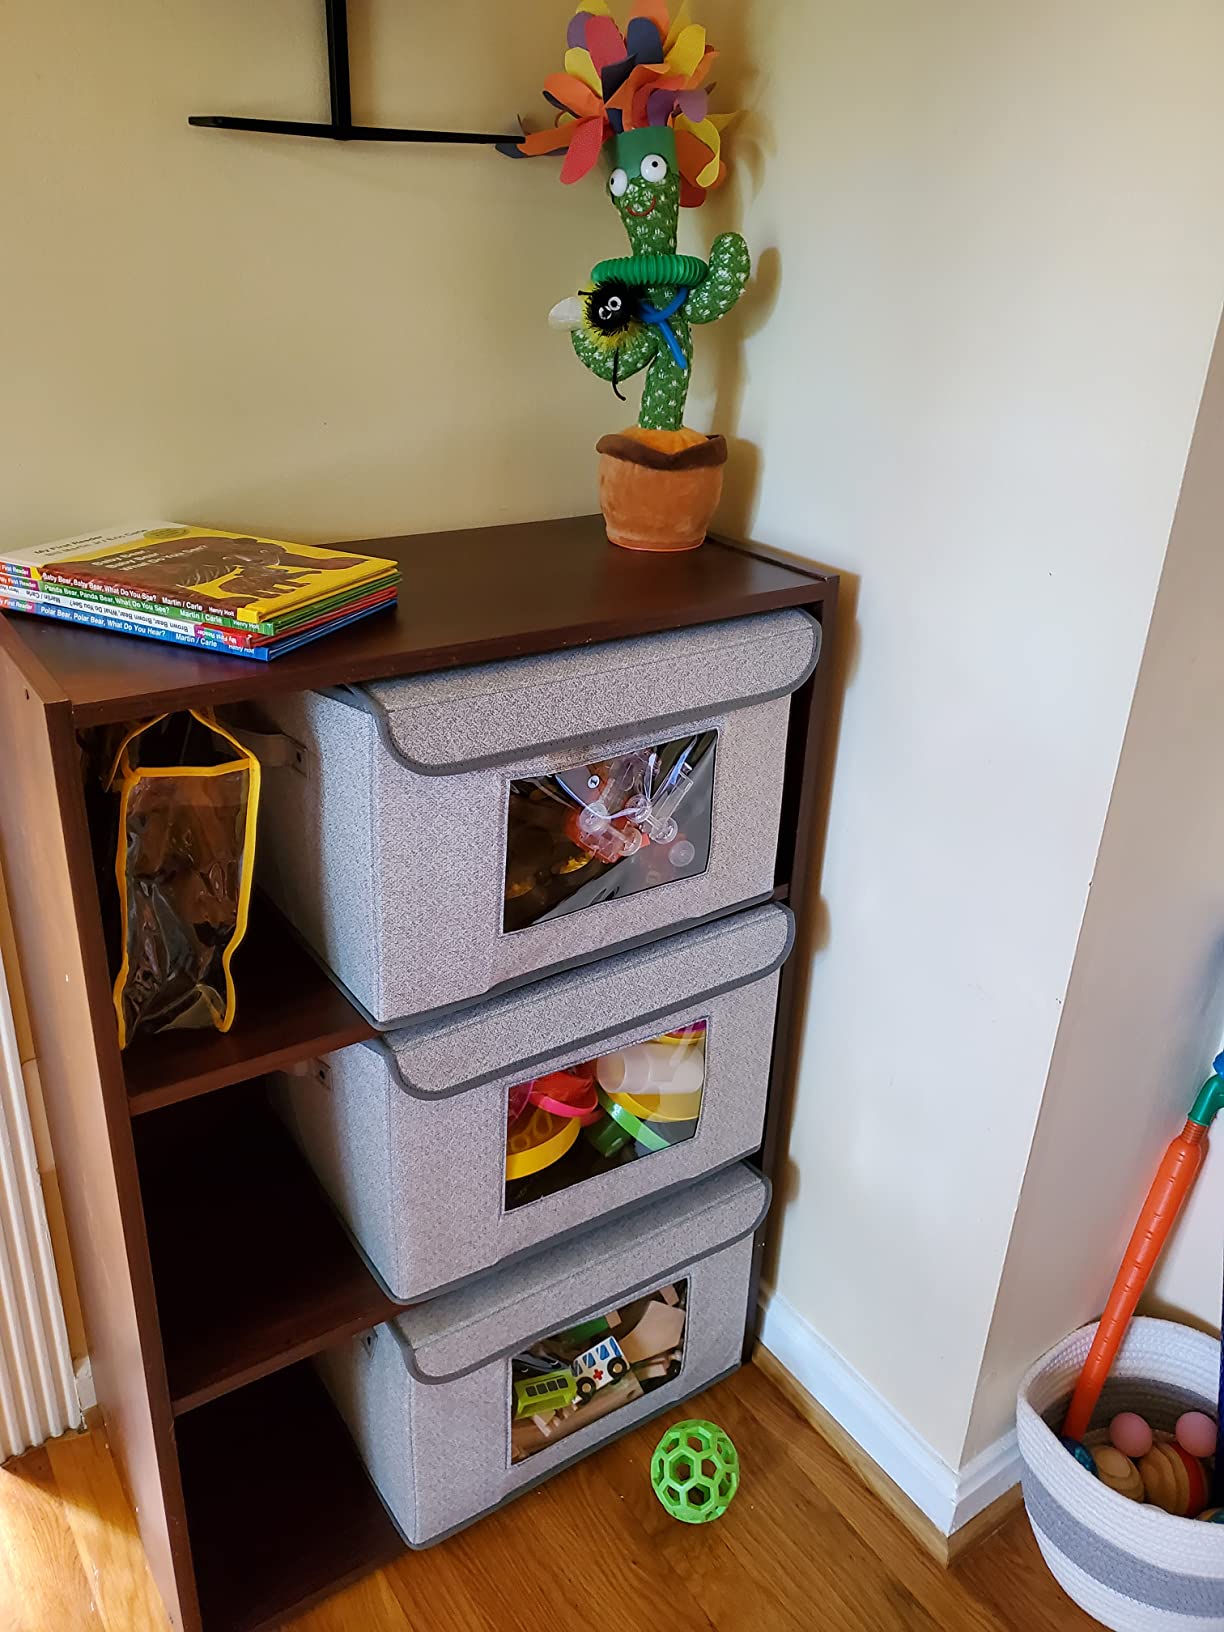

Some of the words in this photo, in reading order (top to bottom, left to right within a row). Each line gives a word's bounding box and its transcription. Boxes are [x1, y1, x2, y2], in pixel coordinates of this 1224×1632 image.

[119, 562, 150, 571] What
[26, 590, 40, 598] Carle
[42, 572, 57, 583] Baby
[58, 575, 73, 586] Bear,
[73, 579, 88, 589] Baby
[89, 582, 104, 592] Bear,
[104, 585, 120, 595] What
[120, 588, 129, 596] Do
[129, 590, 140, 598] You
[141, 592, 157, 602] See?
[161, 596, 182, 607] Martin
[186, 601, 203, 611] Carle
[208, 606, 223, 615] Henry
[44, 595, 60, 603] Martin
[44, 584, 63, 594] Panda
[64, 588, 79, 597] Bear,
[80, 590, 99, 600] Panda
[99, 594, 115, 603] Bear,
[115, 597, 131, 606] What
[132, 600, 140, 608] Do
[141, 602, 153, 610] You
[154, 604, 170, 613] See?
[179, 609, 200, 619] Martin
[205, 613, 223, 624] Carle
[233, 619, 248, 629] Henry
[69, 600, 83, 609] See?
[83, 604, 94, 612] You
[94, 605, 102, 613] Do
[104, 607, 118, 616] What
[118, 610, 133, 620] Bear,
[134, 615, 152, 624] Brown
[152, 618, 168, 628] Bear,
[41, 606, 56, 615] Polar
[57, 609, 72, 619] Bear,
[74, 613, 89, 622] Polar
[90, 616, 106, 626] Bear,
[106, 619, 122, 629] What
[124, 622, 132, 630] Do
[133, 625, 146, 633] You
[147, 627, 166, 637] Hear?
[175, 633, 195, 643] Martin
[200, 637, 218, 648] Carle
[169, 623, 189, 632] Brown
